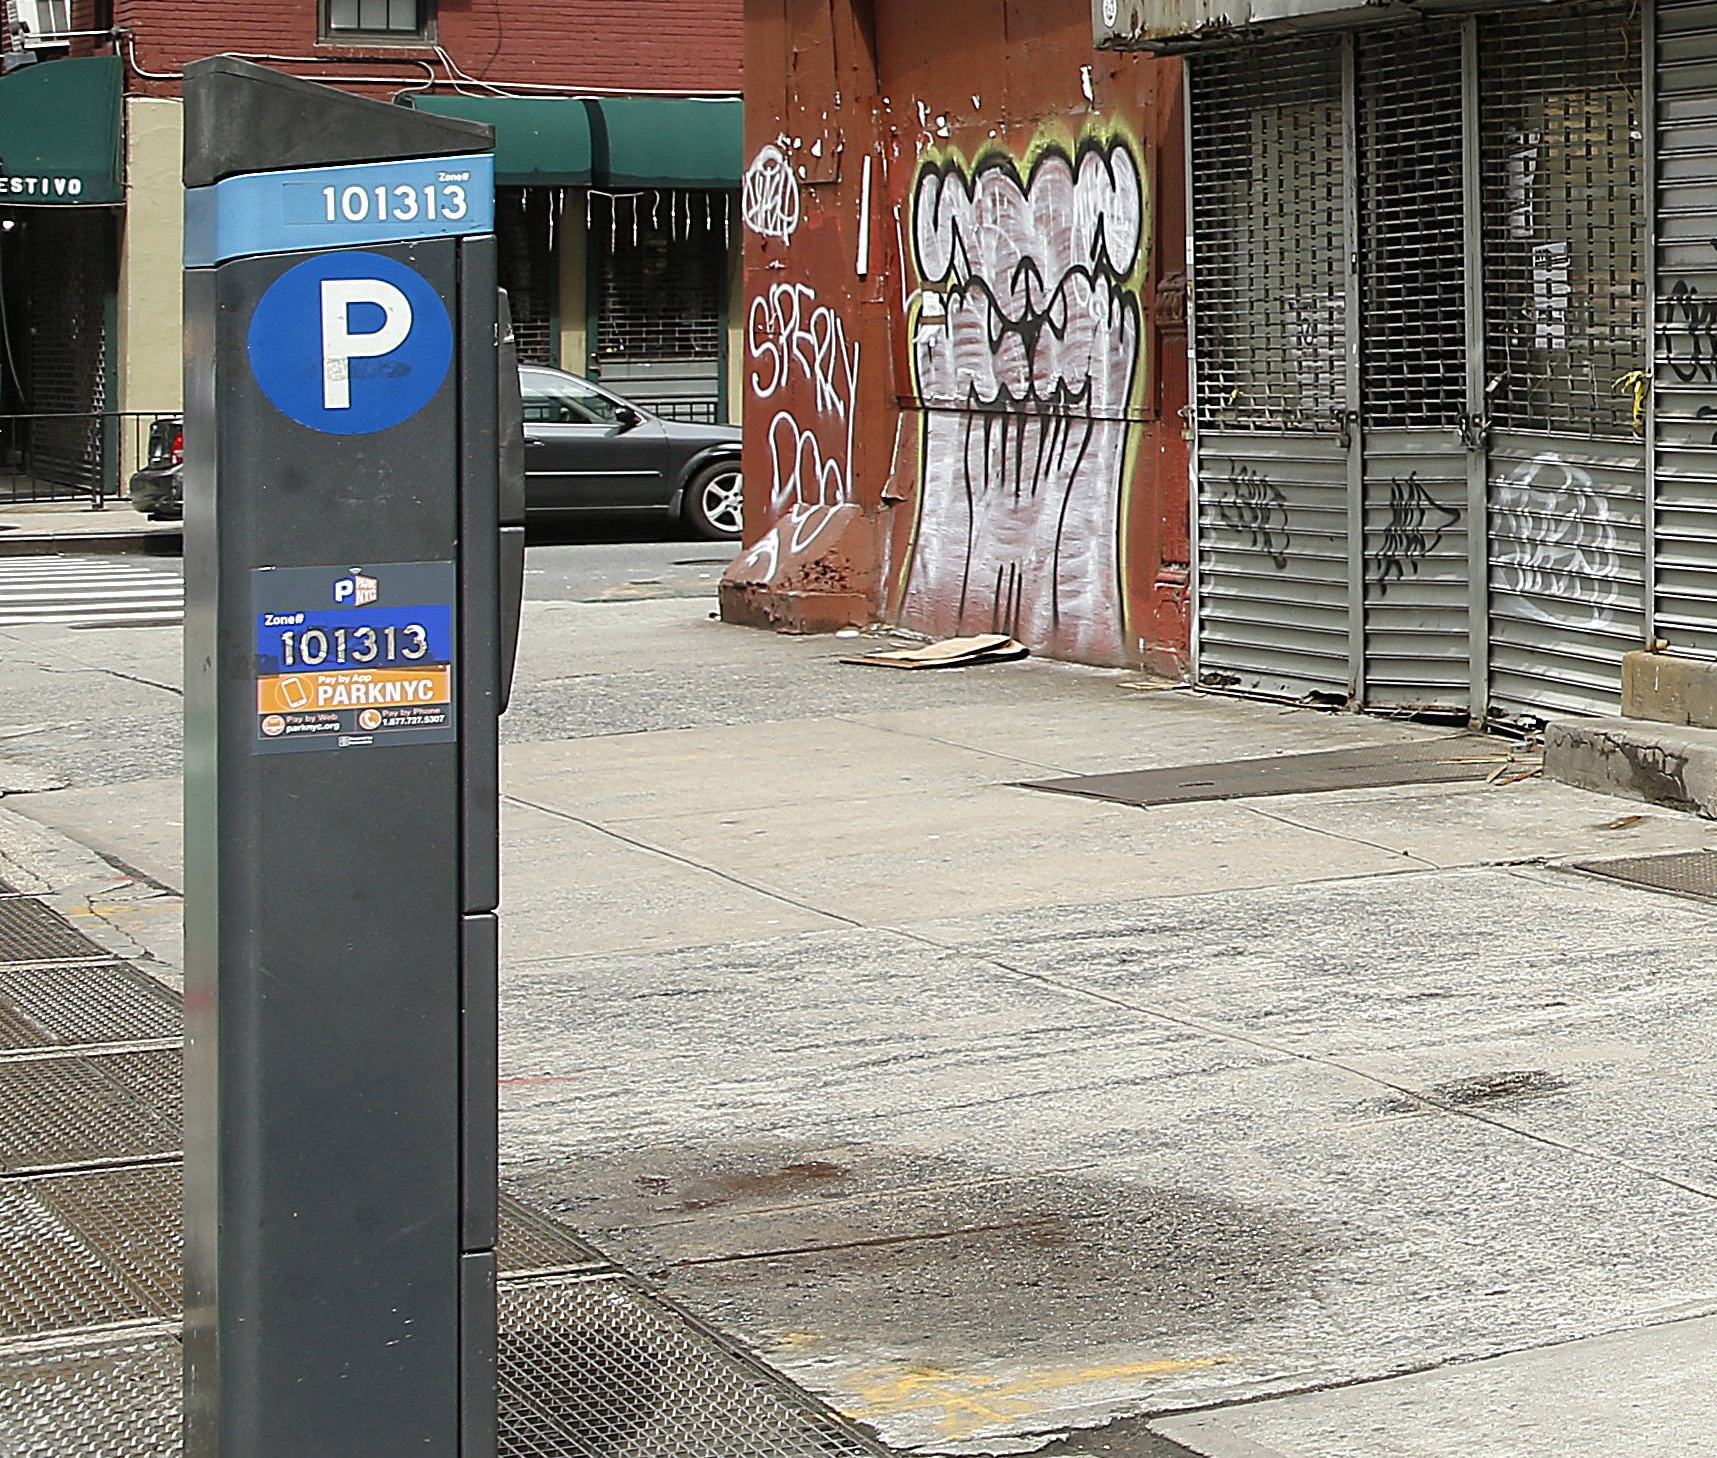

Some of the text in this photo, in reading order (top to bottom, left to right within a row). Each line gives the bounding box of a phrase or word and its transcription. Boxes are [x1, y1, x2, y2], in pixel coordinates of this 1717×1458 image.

[438, 172, 470, 182] Zone#
[322, 184, 468, 222] 101313
[320, 278, 414, 410] P
[264, 613, 305, 626] Zone#
[281, 624, 428, 666] 101313
[317, 674, 372, 685] Pay by App
[317, 679, 434, 706] PARKNYC
[286, 713, 338, 723] Pay by Web
[382, 707, 441, 717] Pay by Phone
[285, 722, 341, 734] parknyc.org
